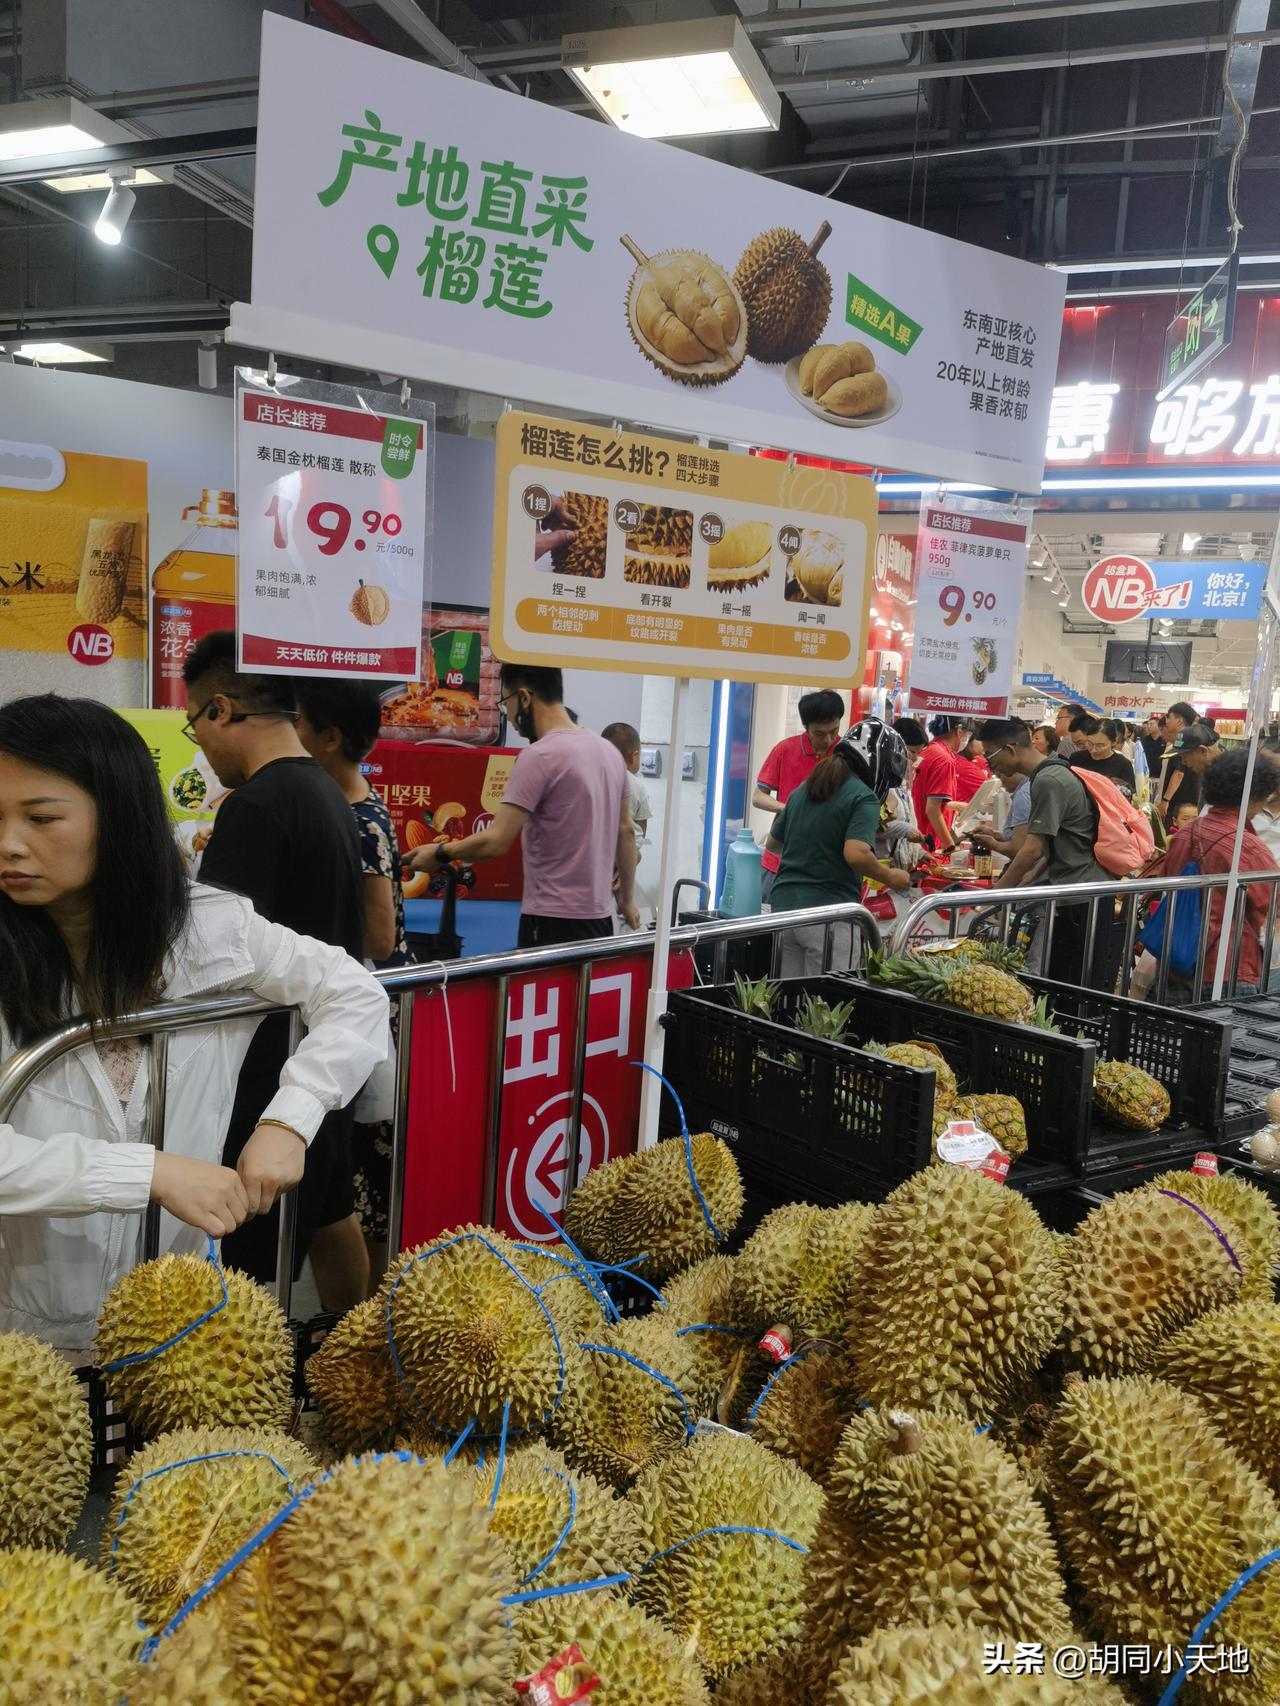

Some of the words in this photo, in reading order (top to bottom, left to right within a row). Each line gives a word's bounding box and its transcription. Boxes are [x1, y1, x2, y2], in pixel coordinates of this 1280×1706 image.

[316, 109, 595, 253] 产地直采
[416, 225, 553, 319] 榴莲
[850, 294, 911, 346] 精选A果
[963, 309, 1037, 346] 东南亚核心
[975, 337, 1035, 368] 产地直发
[936, 361, 1030, 399] 20年以上树龄
[969, 392, 1028, 422] 果香浓郁
[256, 403, 328, 432] 店长推荐
[1045, 381, 1120, 460] 惠
[389, 432, 413, 448] 时令
[387, 447, 411, 462] 尝鲜
[520, 422, 671, 478] 榴莲怎么挑?
[256, 445, 345, 473] 泰国金枕榴莲
[349, 460, 377, 477] 散称
[676, 453, 721, 473] 榴莲挑选
[675, 468, 720, 488] 四大步骤
[931, 514, 972, 533] 店长推荐
[376, 542, 415, 557] 元/500g
[930, 537, 948, 551] 佳农
[928, 552, 951, 568] 950g
[255, 569, 318, 587] 果肉饱满,浓
[1104, 564, 1138, 576] 超盒算
[255, 585, 291, 600] 郁细腻
[551, 582, 587, 599] 捏一捏
[640, 592, 673, 608] 看开裂
[1089, 577, 1146, 609] NB
[1202, 590, 1246, 608] 北京!
[536, 603, 599, 622] 两个相邻的刺
[722, 602, 752, 617] 摇一摇
[797, 611, 826, 625] 闻一闻
[160, 621, 192, 637] 浓香
[625, 613, 684, 631] 底部有明显的
[71, 631, 113, 657] NB
[276, 646, 329, 664] 天天低价
[331, 650, 382, 667] 件件爆款
[447, 673, 464, 685] NB
[926, 696, 957, 708] 天天低价
[1104, 695, 1155, 708] 肉禽水产
[503, 971, 633, 1085] 出口
